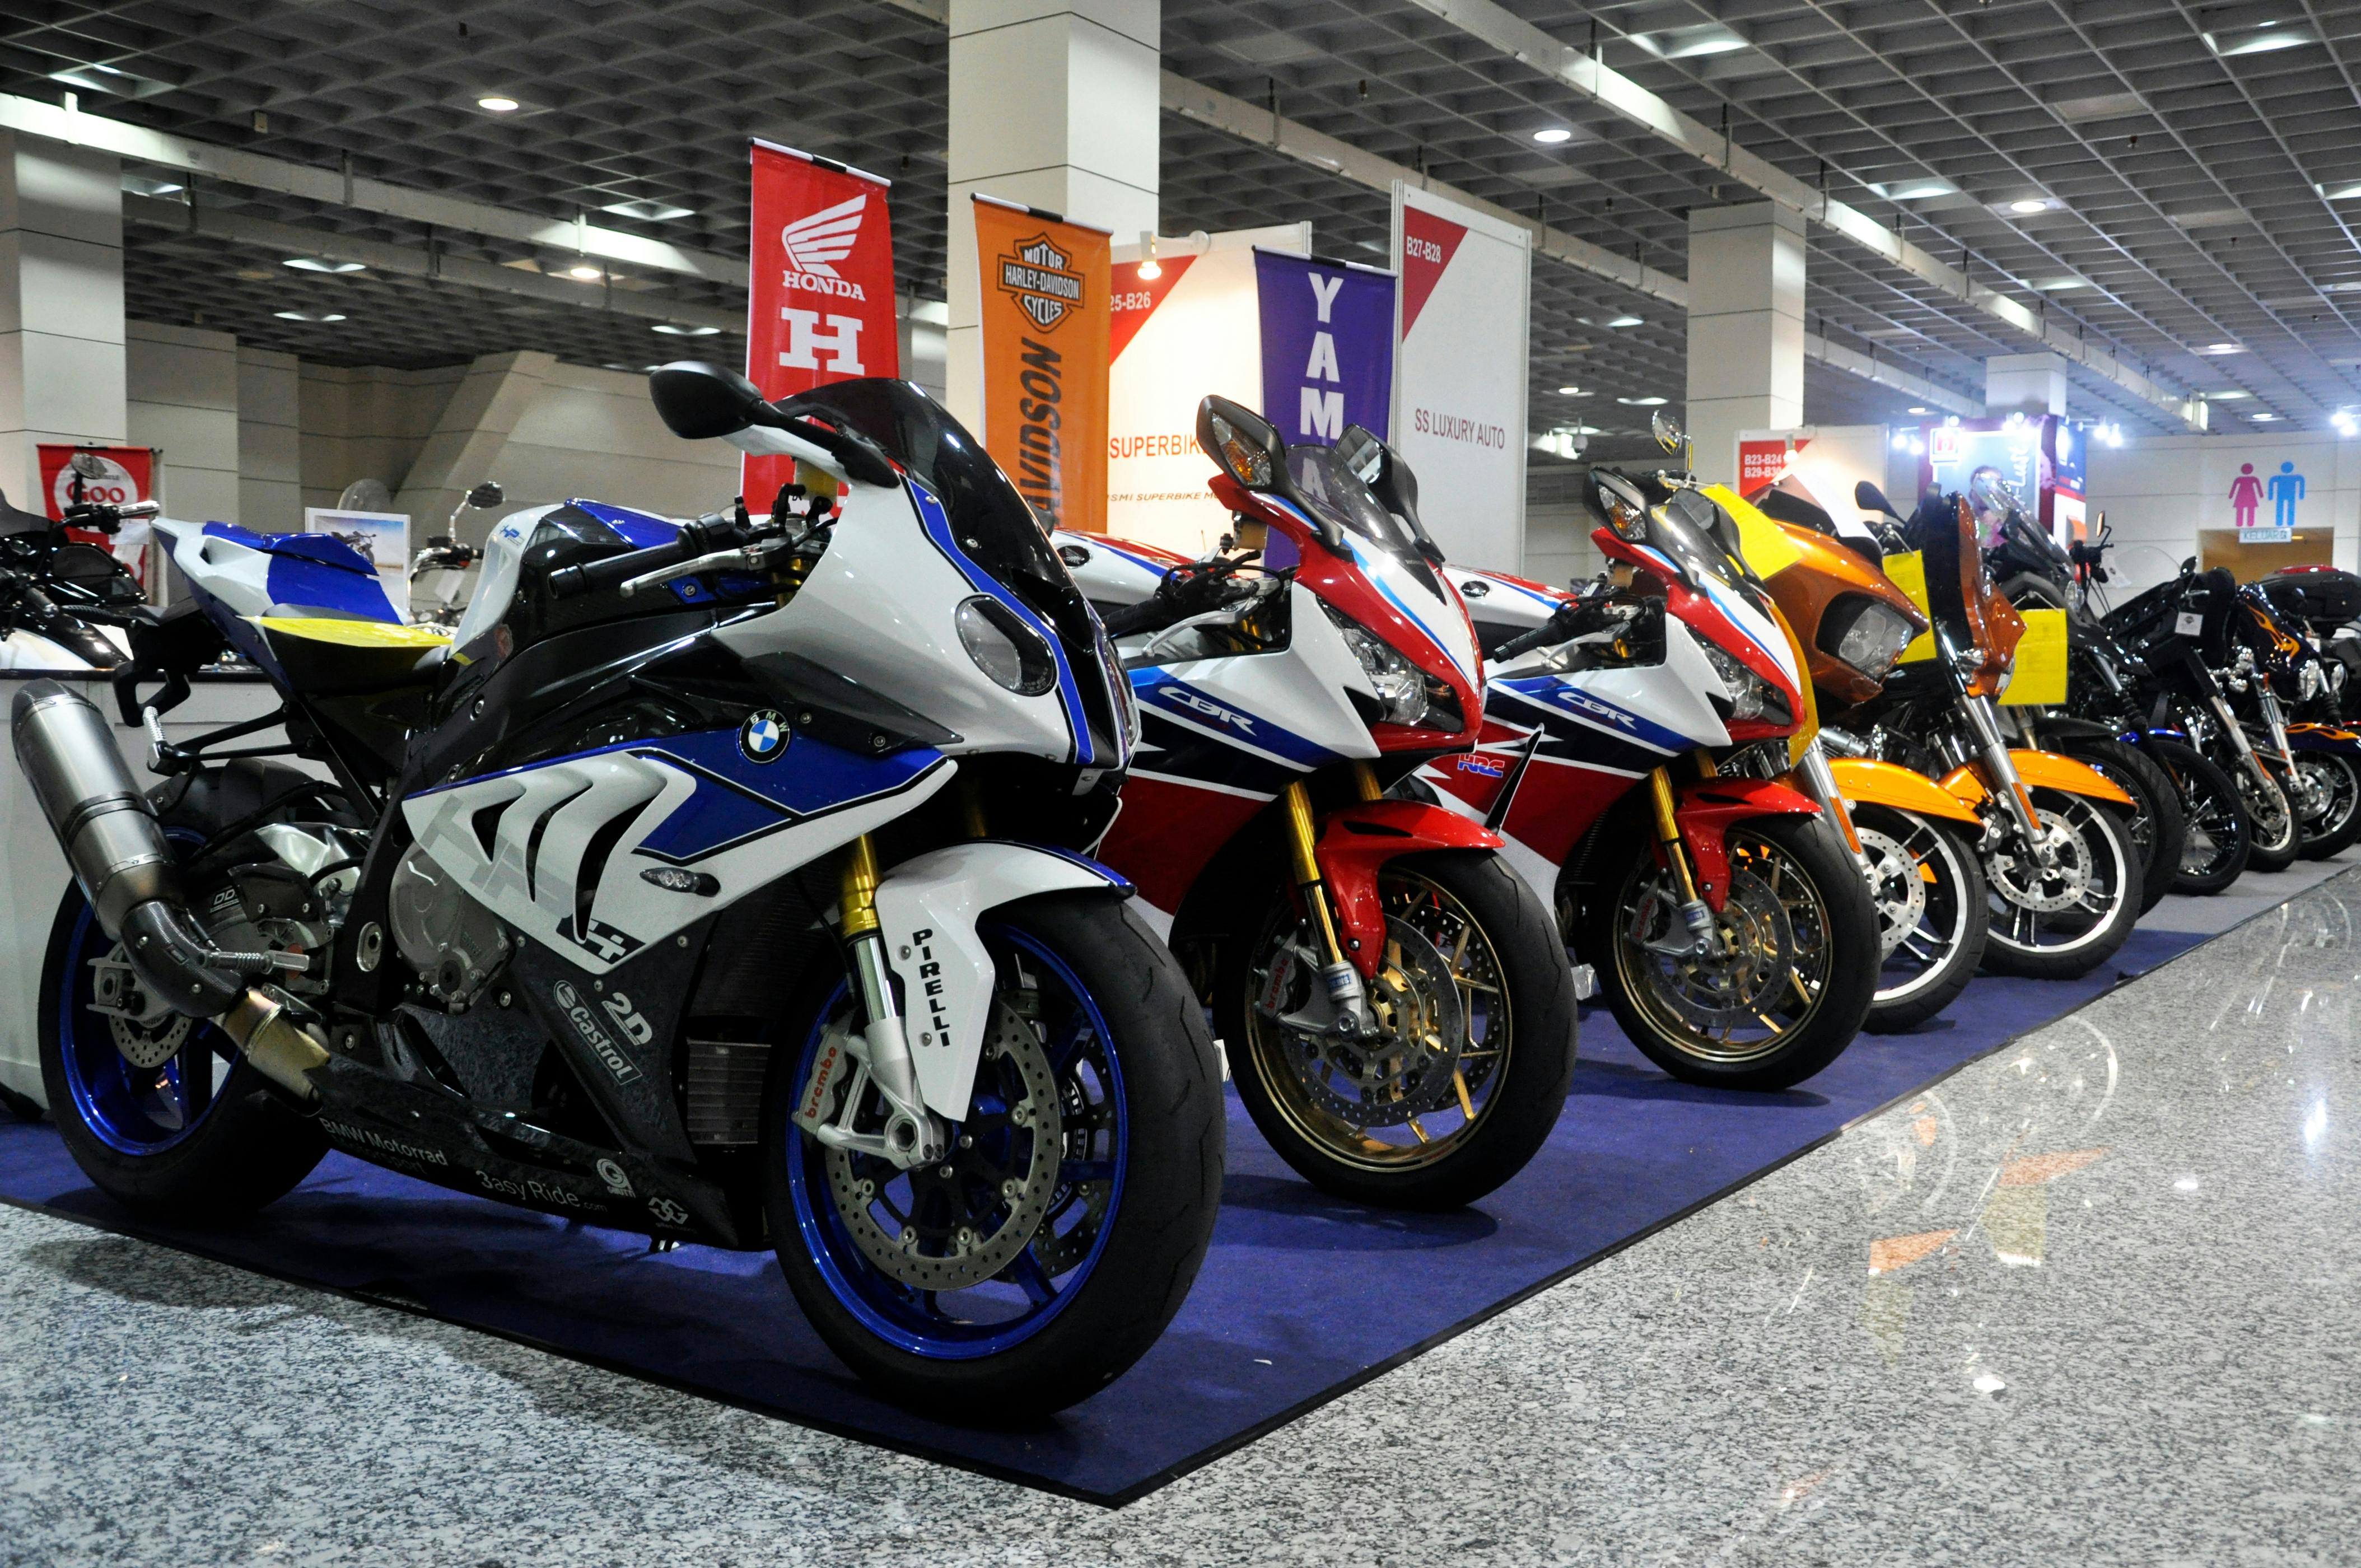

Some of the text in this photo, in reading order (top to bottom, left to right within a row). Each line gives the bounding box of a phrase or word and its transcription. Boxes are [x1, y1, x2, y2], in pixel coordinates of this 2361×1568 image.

[1024, 243, 1063, 270] MOTOR
[1406, 236, 1441, 264] B27-B28
[782, 270, 866, 301] HONDA
[1005, 264, 1079, 300] HARLEY-DAVIDSON
[1024, 295, 1062, 324] CYCLES
[779, 307, 865, 376] H
[1109, 434, 1207, 459] SUPERBIK
[1415, 408, 1505, 449] SS LUXURY AUTO
[1744, 454, 1782, 465] B23-B24
[1136, 492, 1202, 501] SUPERBIKE
[750, 711, 788, 732] BMW
[1158, 686, 1258, 736] CBR
[1557, 692, 1637, 730] CBR
[1457, 754, 1505, 778] HRC
[213, 888, 237, 906] DD
[912, 928, 950, 1048] PIRELLI
[1265, 958, 1289, 1009] brembo
[601, 992, 652, 1046] 2D
[570, 1007, 633, 1079] Castrol
[805, 1046, 837, 1119] brembo
[319, 1117, 449, 1166] BMW Motorrad
